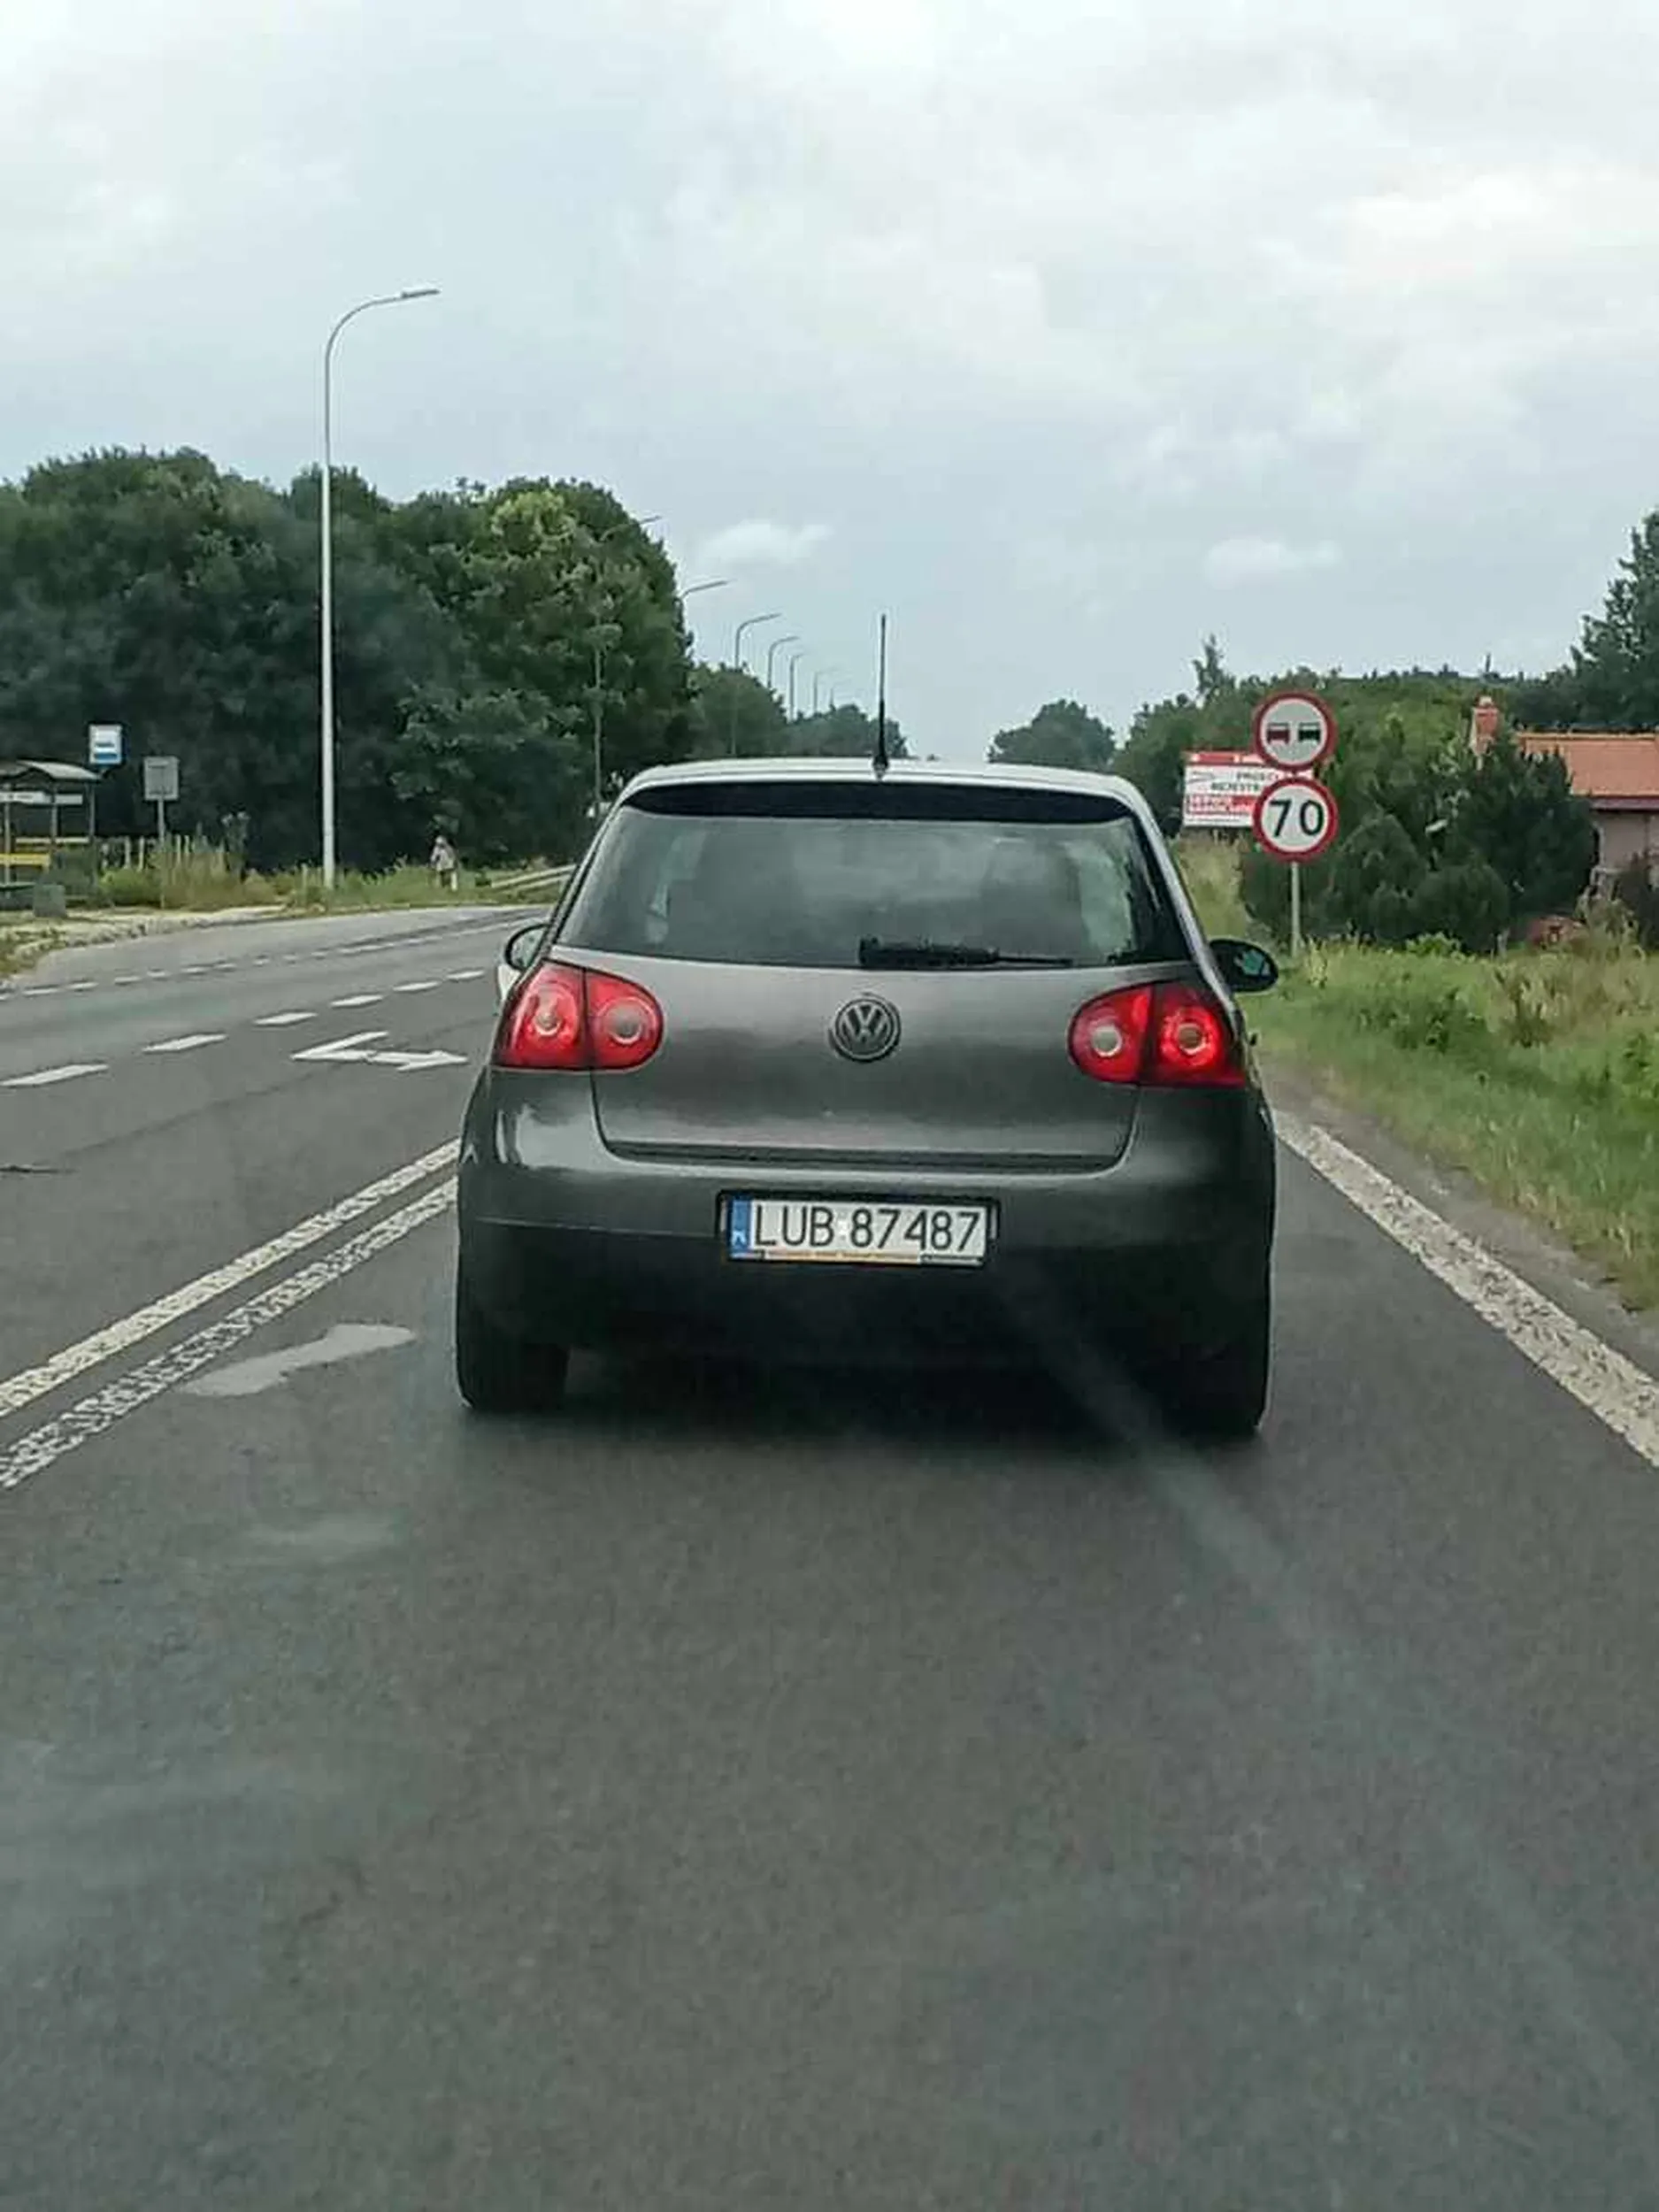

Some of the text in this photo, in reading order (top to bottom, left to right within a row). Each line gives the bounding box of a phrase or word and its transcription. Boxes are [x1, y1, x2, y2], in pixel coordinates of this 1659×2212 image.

[1269, 799, 1325, 837] 70
[756, 1205, 980, 1251] LUB 87487
